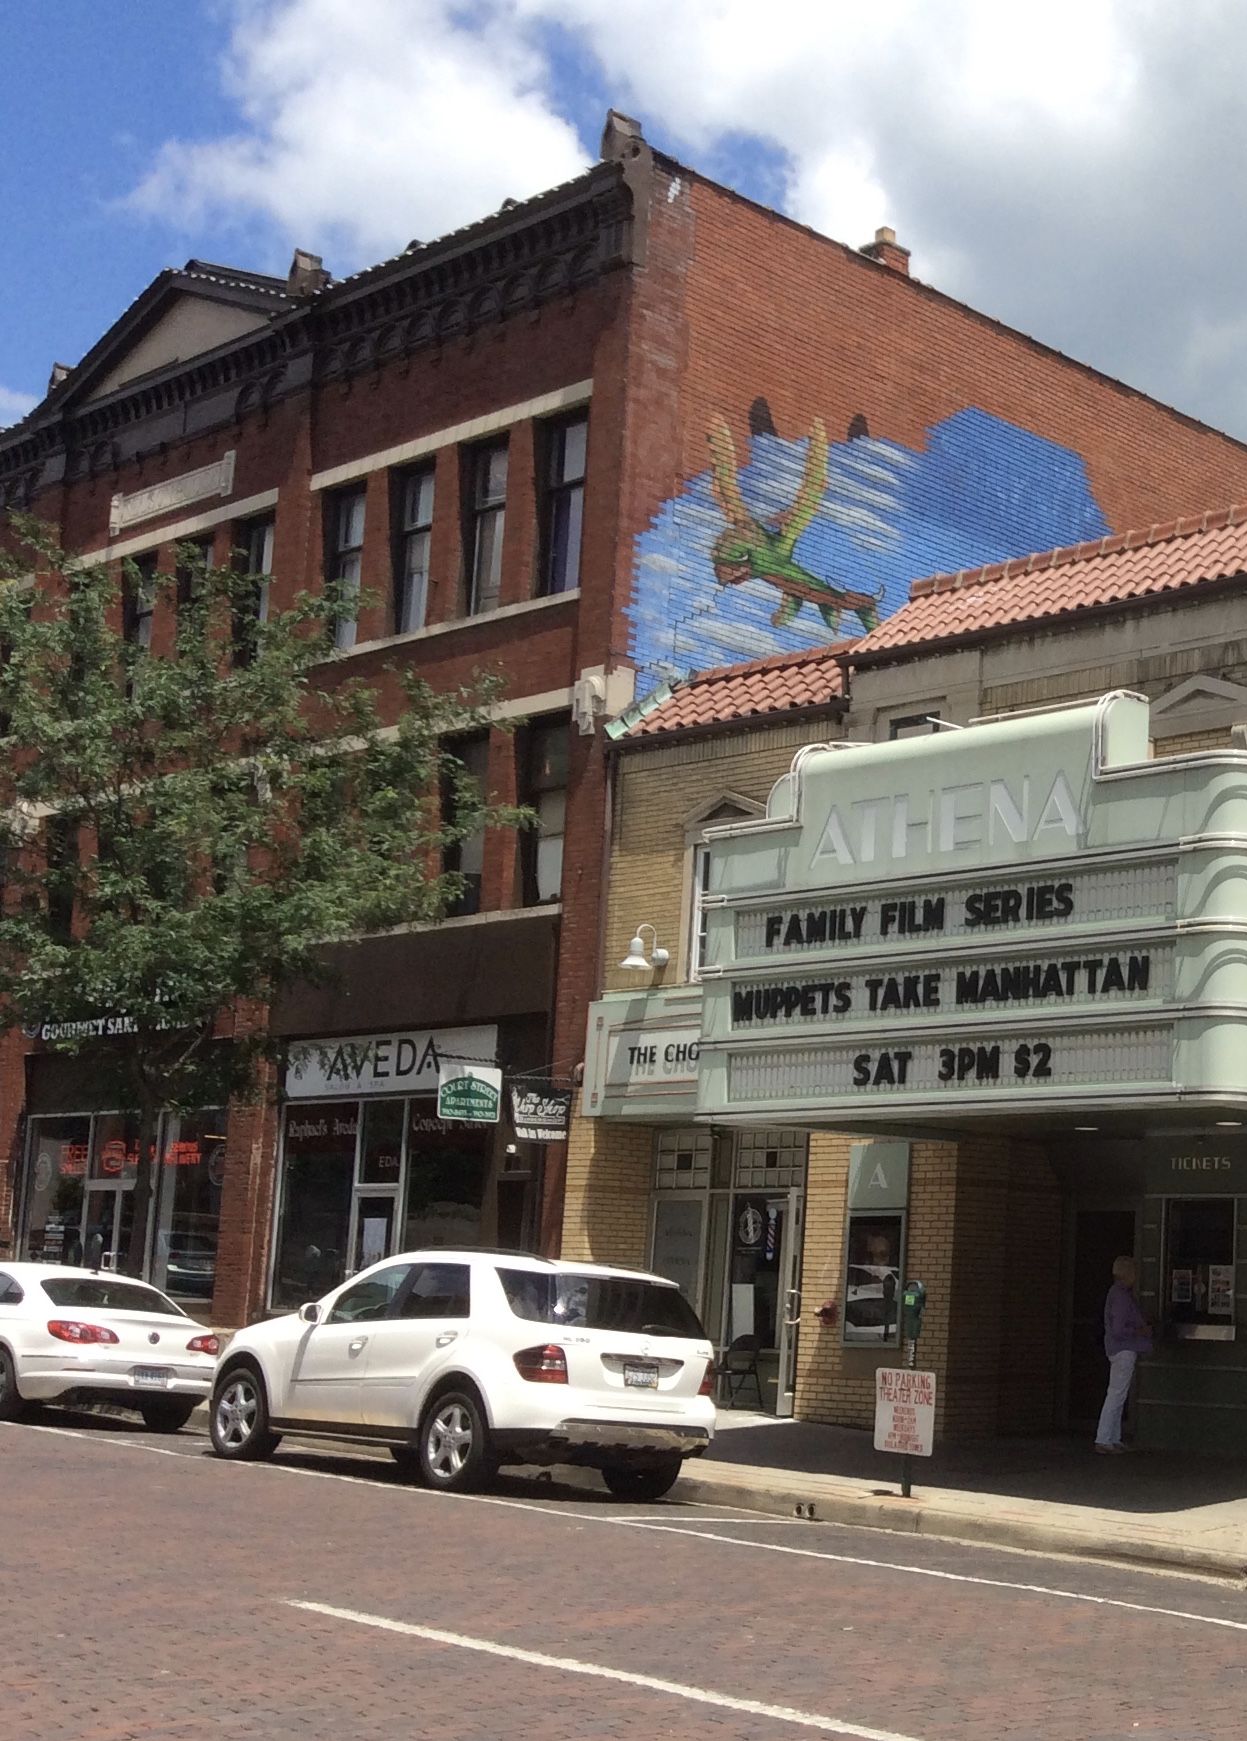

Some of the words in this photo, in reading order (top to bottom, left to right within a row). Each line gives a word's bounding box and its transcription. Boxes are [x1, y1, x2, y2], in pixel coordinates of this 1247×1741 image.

[810, 769, 1087, 870] ATHENA
[765, 906, 867, 948] FAMILY
[880, 897, 945, 936] FILM
[964, 883, 1074, 928] SERIES
[732, 981, 853, 1022] MUPPETS
[865, 973, 941, 1011] TAKE
[956, 956, 1150, 1005] MANHATTAN
[41, 1016, 106, 1040] GOURMET
[326, 1035, 440, 1081] AVEDA
[628, 1046, 657, 1064] THE
[853, 1051, 912, 1086] SAT
[938, 1046, 999, 1081] 3PM
[1013, 1043, 1052, 1077] $2
[440, 1080, 469, 1098] COURT
[470, 1081, 498, 1102] STREET
[445, 1096, 493, 1109] APARTMENTS
[867, 1162, 889, 1189] A
[1170, 1156, 1232, 1171] TICKETS
[881, 1371, 893, 1386] NO
[895, 1372, 931, 1390] PARKING
[879, 1386, 911, 1404] THEATER
[914, 1389, 933, 1406] ZONE
